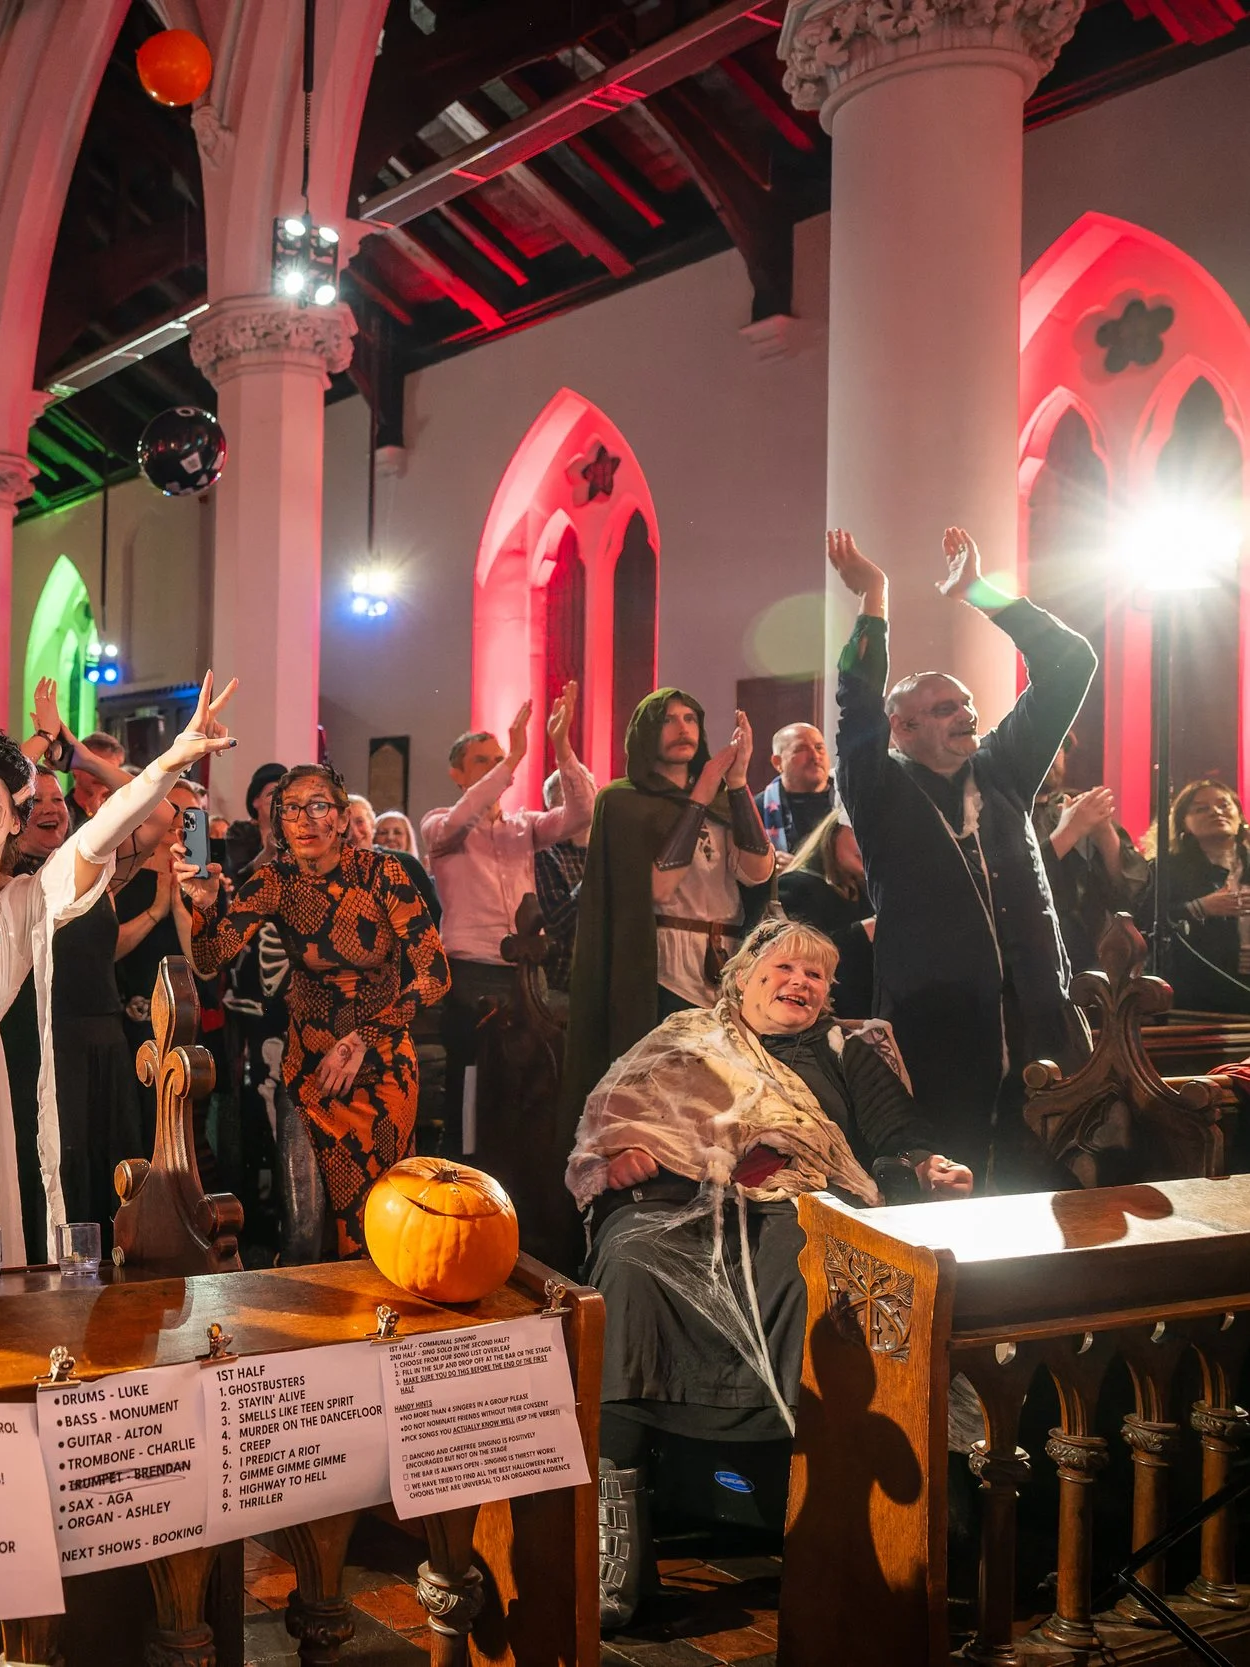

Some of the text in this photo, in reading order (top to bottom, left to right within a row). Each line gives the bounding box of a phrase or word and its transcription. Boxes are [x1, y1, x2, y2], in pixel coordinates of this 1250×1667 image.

[418, 1339, 452, 1348] COMMUNAL
[454, 1335, 477, 1343] SINGING
[399, 1359, 422, 1367] CHOOSE
[424, 1356, 439, 1364] FROM
[453, 1351, 470, 1359] SONG
[483, 1345, 510, 1354] OVERLEAF
[216, 1365, 265, 1381] 1ST HALF
[62, 1390, 105, 1405] DRUMS
[118, 1384, 148, 1398] LUKE
[219, 1376, 305, 1396] 1. GHOSTBUSTERS
[221, 1390, 305, 1411] 2. STAYIN' ALIVE
[221, 1396, 354, 1426] 3. SMELLS LIKE TEEN SPIRIT
[394, 1400, 432, 1412] HANDY HINTS
[65, 1413, 97, 1427] BASS
[109, 1400, 179, 1420] MONUMENT
[222, 1405, 382, 1440] 4. MURDER ON THE DANCEFLOOR
[404, 1424, 412, 1432] DO
[427, 1416, 456, 1427] NOMINATE
[457, 1412, 480, 1421] FRIENDS
[481, 1408, 506, 1417] WITHOUT
[523, 1400, 548, 1410] CONSENT
[67, 1432, 112, 1448] GUITAR
[125, 1424, 162, 1439] ALTON
[222, 1439, 271, 1455] 5. CREEP
[68, 1449, 135, 1469] TROMBONE
[147, 1438, 195, 1455] CHARLIE
[222, 1444, 320, 1470] 6. I PREDICT A RIOT
[406, 1457, 443, 1469] ENCOURAGED
[456, 1452, 467, 1460] NOT
[490, 1445, 507, 1454] STAGE
[223, 1454, 346, 1484] 7. GIMME GIMME GIMME
[409, 1489, 434, 1499] CHOONS
[435, 1486, 448, 1494] THAT
[462, 1478, 492, 1488] UNIVERSAL
[511, 1468, 541, 1479] ORGANOKE
[542, 1463, 570, 1473] AUDIENCE
[422, 1480, 436, 1488] HAVE
[463, 1472, 475, 1480] FIND
[498, 1465, 511, 1473] BEST
[512, 1459, 546, 1470] HALLOWEEN
[546, 1456, 564, 1464] PARTY
[223, 1471, 327, 1498] 8. HIGHWAY TO HELL
[69, 1498, 93, 1512] SAX
[107, 1492, 133, 1506] AGA
[222, 1493, 283, 1512] 9. THRILLER
[67, 1512, 113, 1529] ORGAN
[126, 1501, 170, 1519] ASHLEY
[62, 1547, 94, 1562] NEXT
[98, 1539, 141, 1555] SHOWS
[153, 1525, 203, 1544] BOOKING
